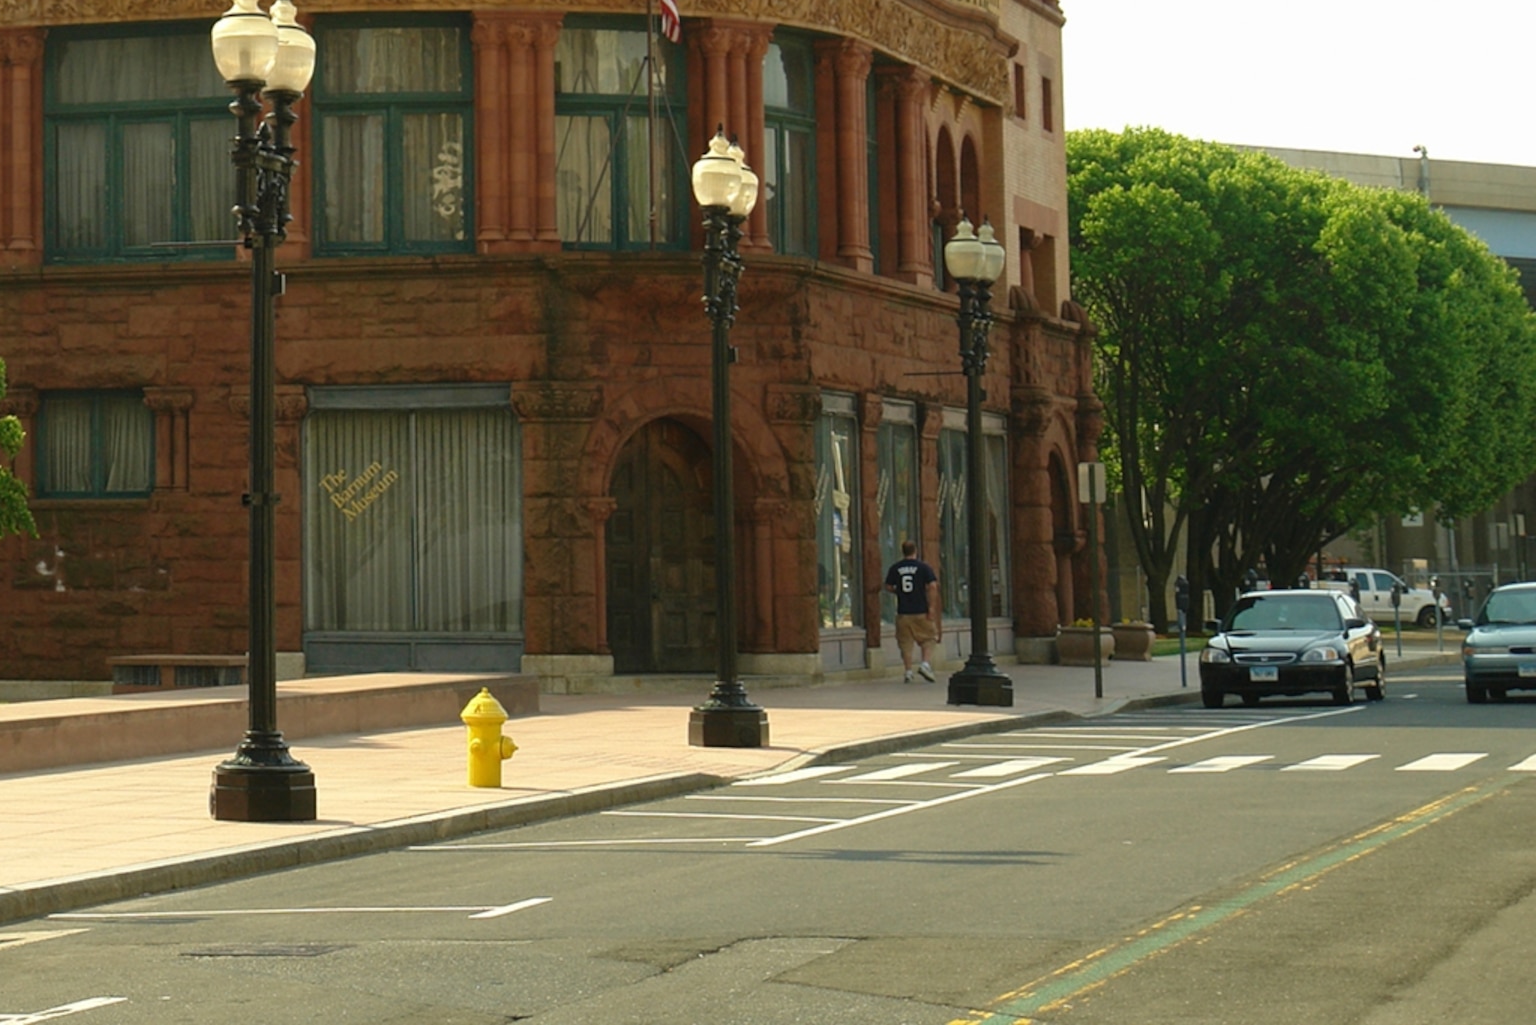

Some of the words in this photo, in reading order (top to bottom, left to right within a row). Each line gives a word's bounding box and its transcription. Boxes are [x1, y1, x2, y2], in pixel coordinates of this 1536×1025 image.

[318, 468, 347, 494] The
[329, 460, 382, 509] Barnum
[342, 469, 399, 523] Museum
[901, 574, 914, 593] 6
